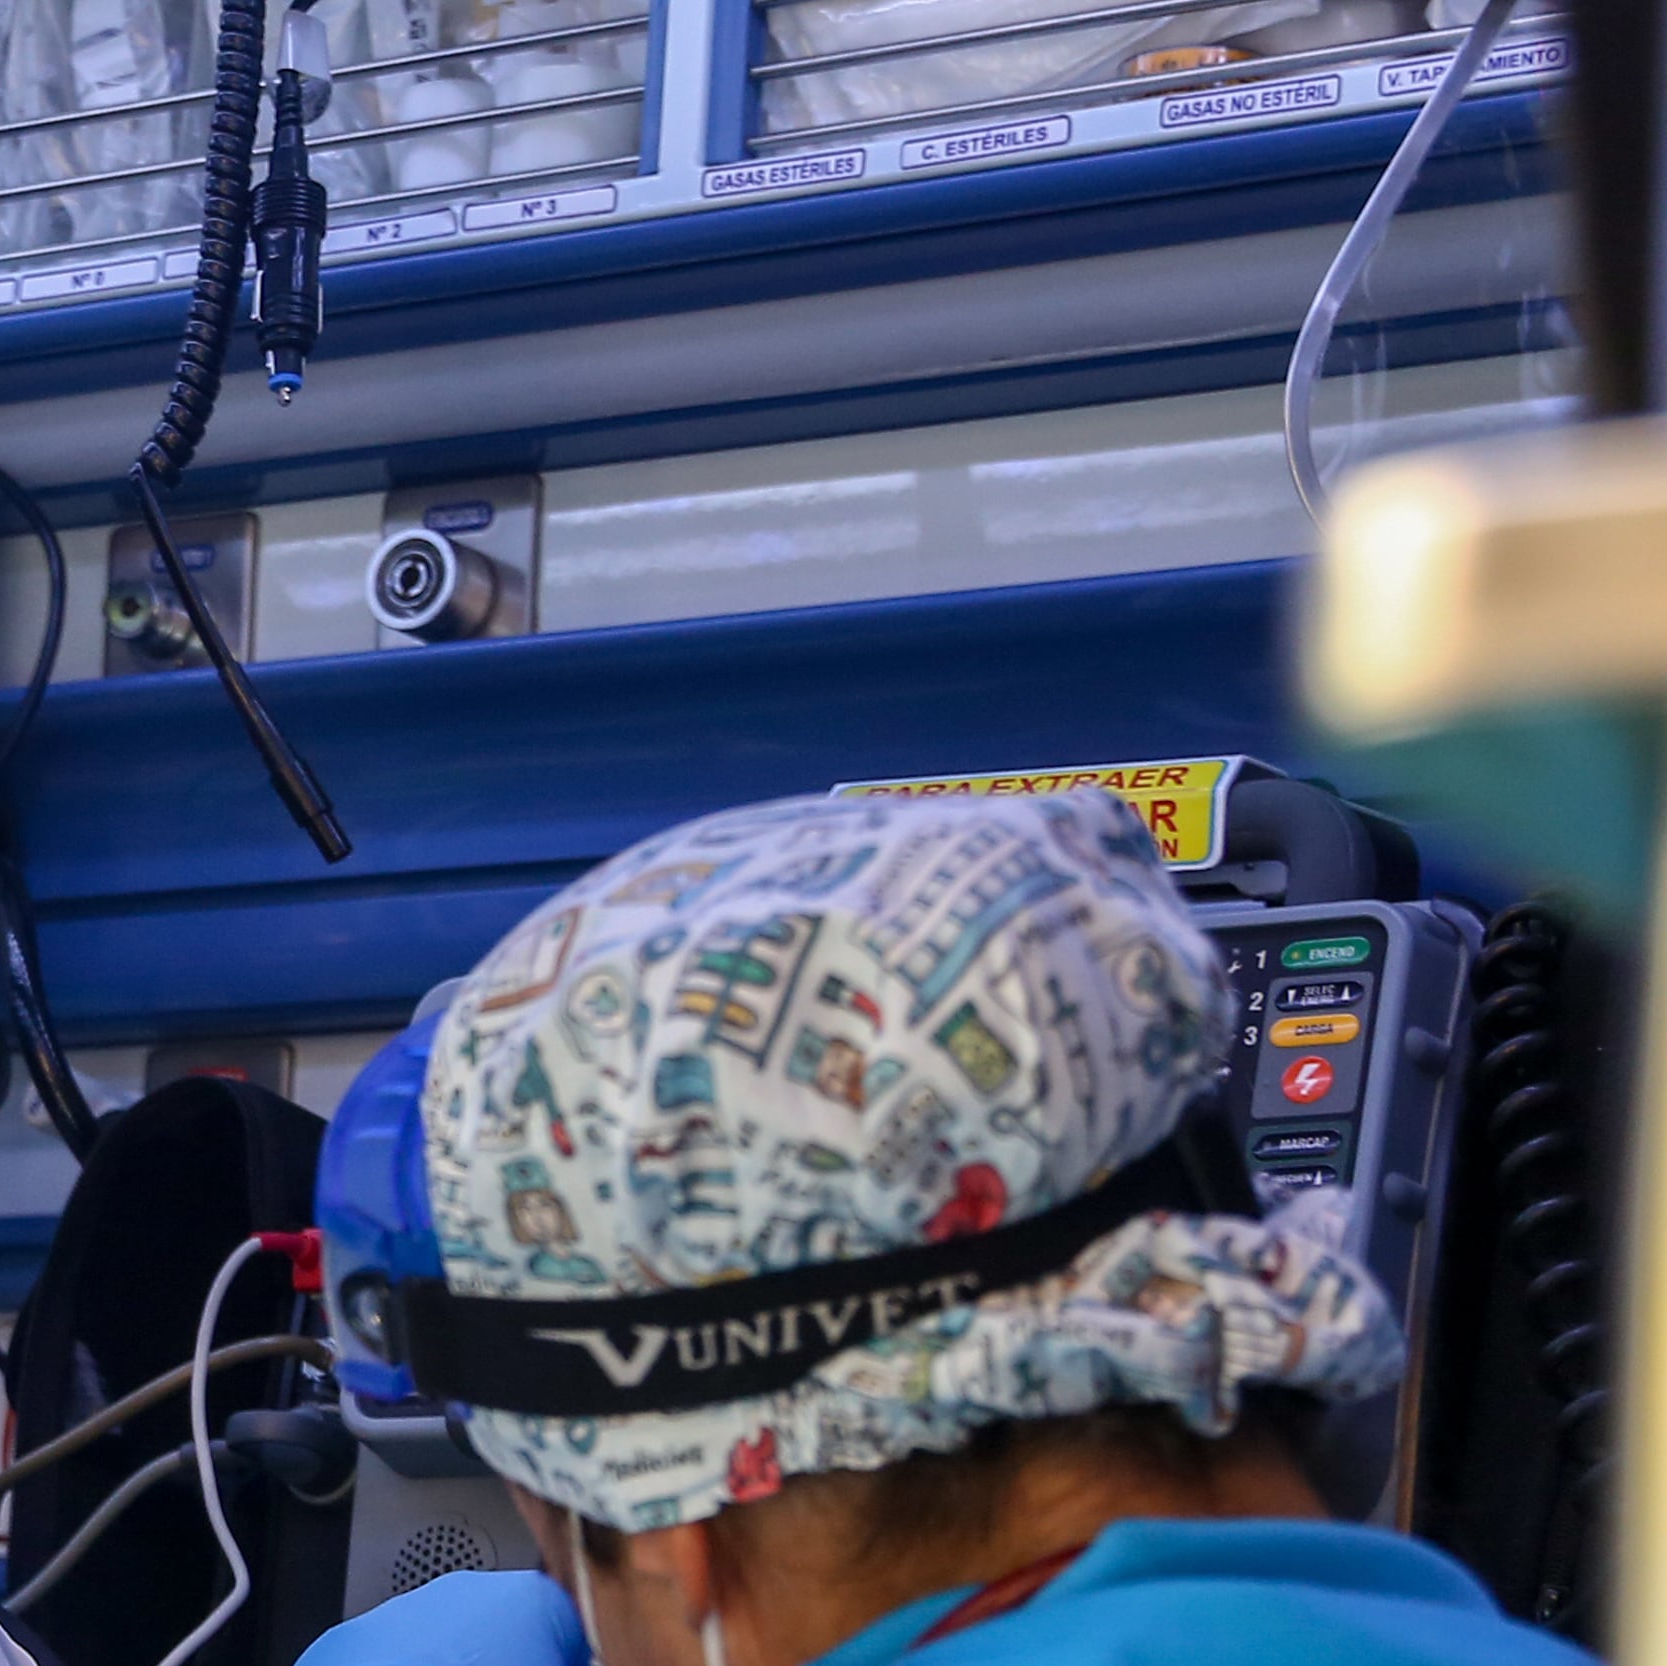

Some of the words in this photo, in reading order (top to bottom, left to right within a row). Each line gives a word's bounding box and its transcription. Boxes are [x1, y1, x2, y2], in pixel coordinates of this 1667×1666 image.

[1167, 99, 1225, 122] GASAS
[1231, 94, 1256, 113] NO
[1261, 81, 1332, 108] ESTÉRIL
[922, 145, 940, 160] C.
[946, 126, 1048, 156] ESTÉRILES
[711, 170, 766, 192] GASAS
[769, 156, 855, 184] ESTÉRILES
[546, 200, 557, 215] 3
[390, 224, 402, 239] 2
[94, 271, 105, 286] 0
[1255, 950, 1267, 970] 1
[1248, 991, 1265, 1011] 2
[1243, 1026, 1258, 1046] 3
[670, 1271, 979, 1372] UNIVET
